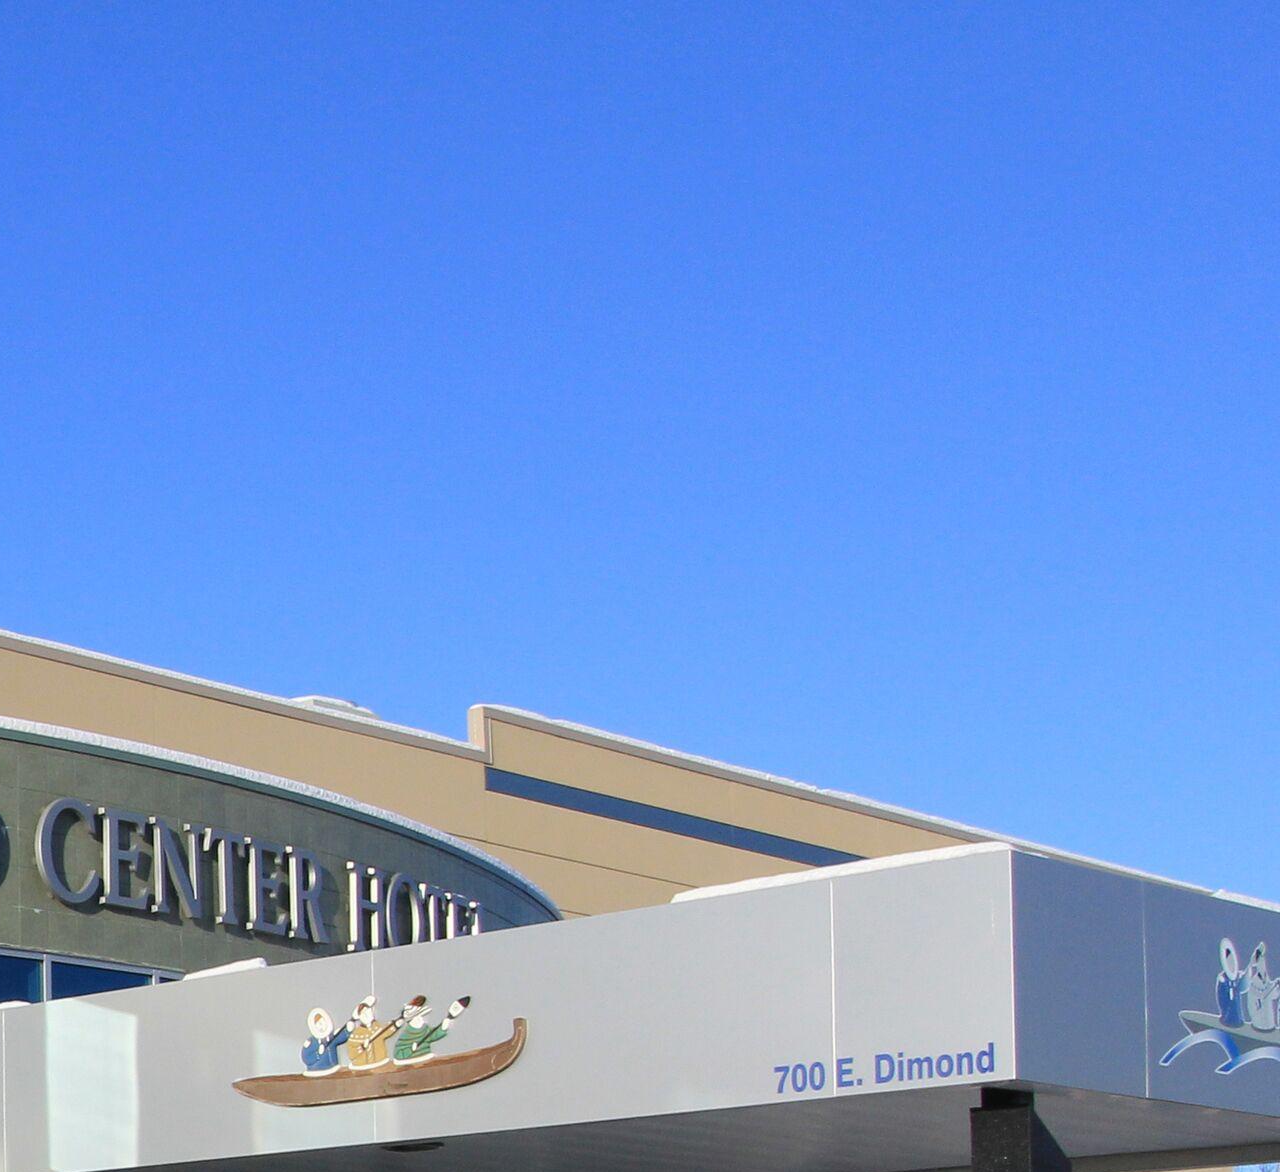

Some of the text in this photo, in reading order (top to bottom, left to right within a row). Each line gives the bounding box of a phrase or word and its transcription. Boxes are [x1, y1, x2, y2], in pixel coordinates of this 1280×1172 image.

[35, 797, 331, 944] CENTER
[774, 1042, 995, 1093] 700 E. Dimond
